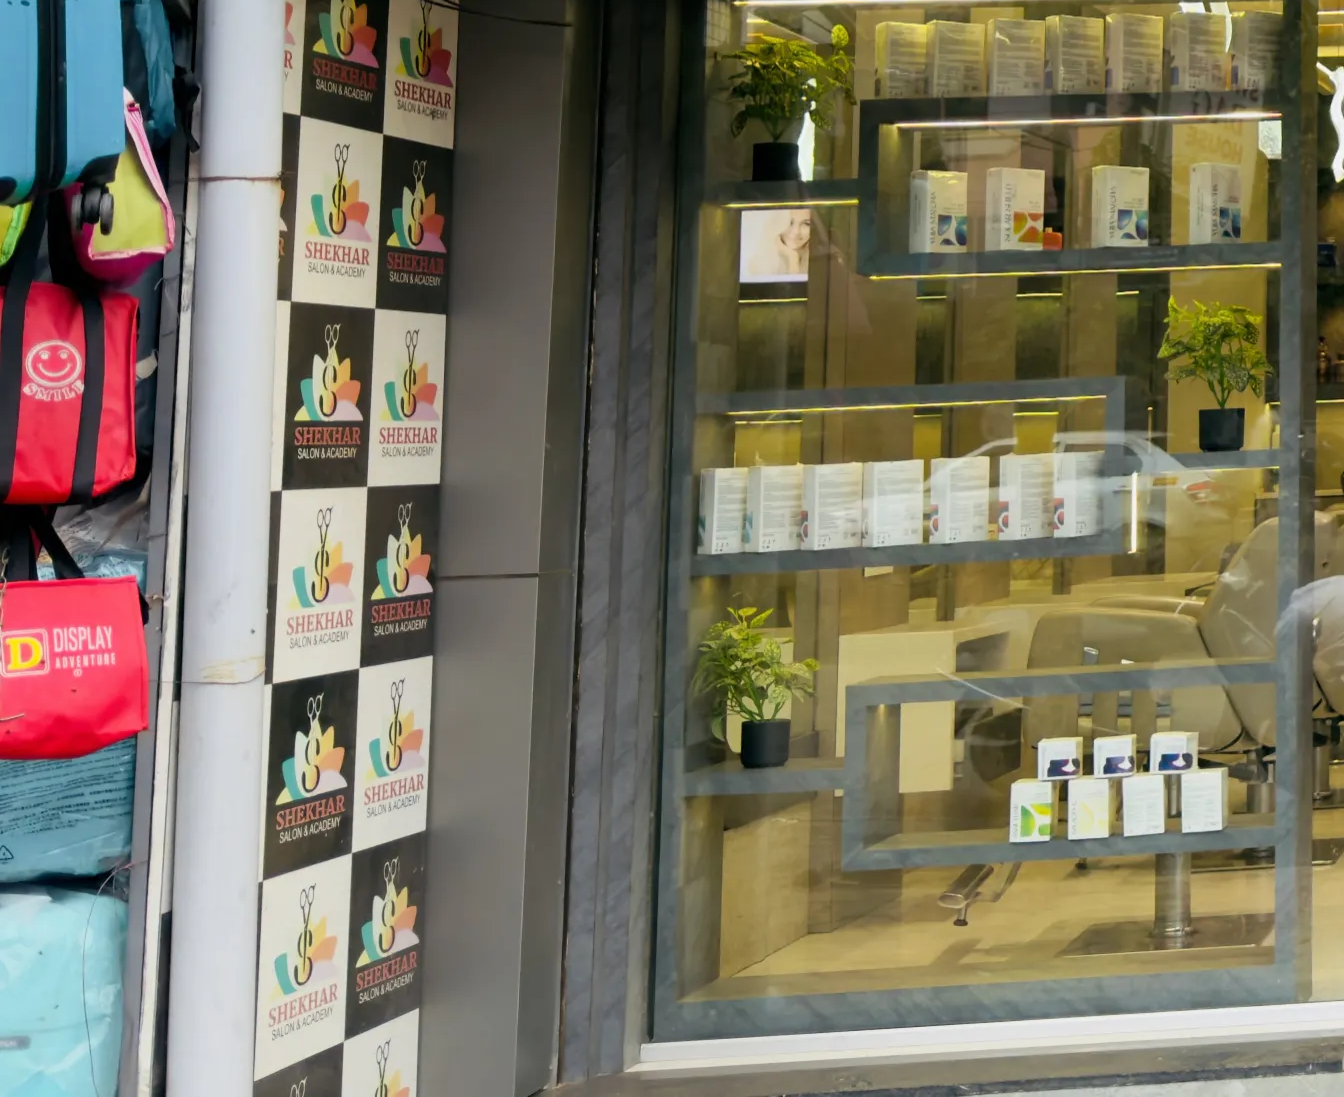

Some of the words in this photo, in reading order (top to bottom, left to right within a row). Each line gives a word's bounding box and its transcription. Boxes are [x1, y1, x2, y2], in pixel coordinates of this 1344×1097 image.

[313, 58, 377, 90] SHEKHAR
[315, 78, 338, 94] SALON
[394, 80, 452, 110] SHEKHAR
[397, 99, 416, 113] SALON
[305, 241, 370, 266] SHEKHAR
[386, 252, 445, 275] SHEKHAR
[308, 261, 330, 275] SALON
[389, 271, 410, 284] SALON
[294, 426, 361, 446] SHEKHAR
[378, 426, 438, 446] SHEKHAR
[297, 447, 320, 460] SALON
[381, 446, 402, 458] SALON
[371, 599, 431, 624] SHEKHAR
[286, 608, 354, 636] SHEKHAR
[373, 623, 395, 637] SALON
[53, 625, 113, 653] DISPLAY
[289, 634, 312, 650] SALON
[5, 635, 44, 672] D
[54, 653, 117, 670] ADVENTURE
[363, 772, 425, 806] SHEKHAR
[275, 794, 346, 831] SHEKHAR
[366, 804, 387, 819] SALON
[278, 826, 303, 845] SALON
[355, 951, 418, 993] SHEKHAR
[268, 982, 339, 1029] SHEKHAR
[358, 987, 381, 1005] SALON
[271, 1022, 296, 1042] SALON
